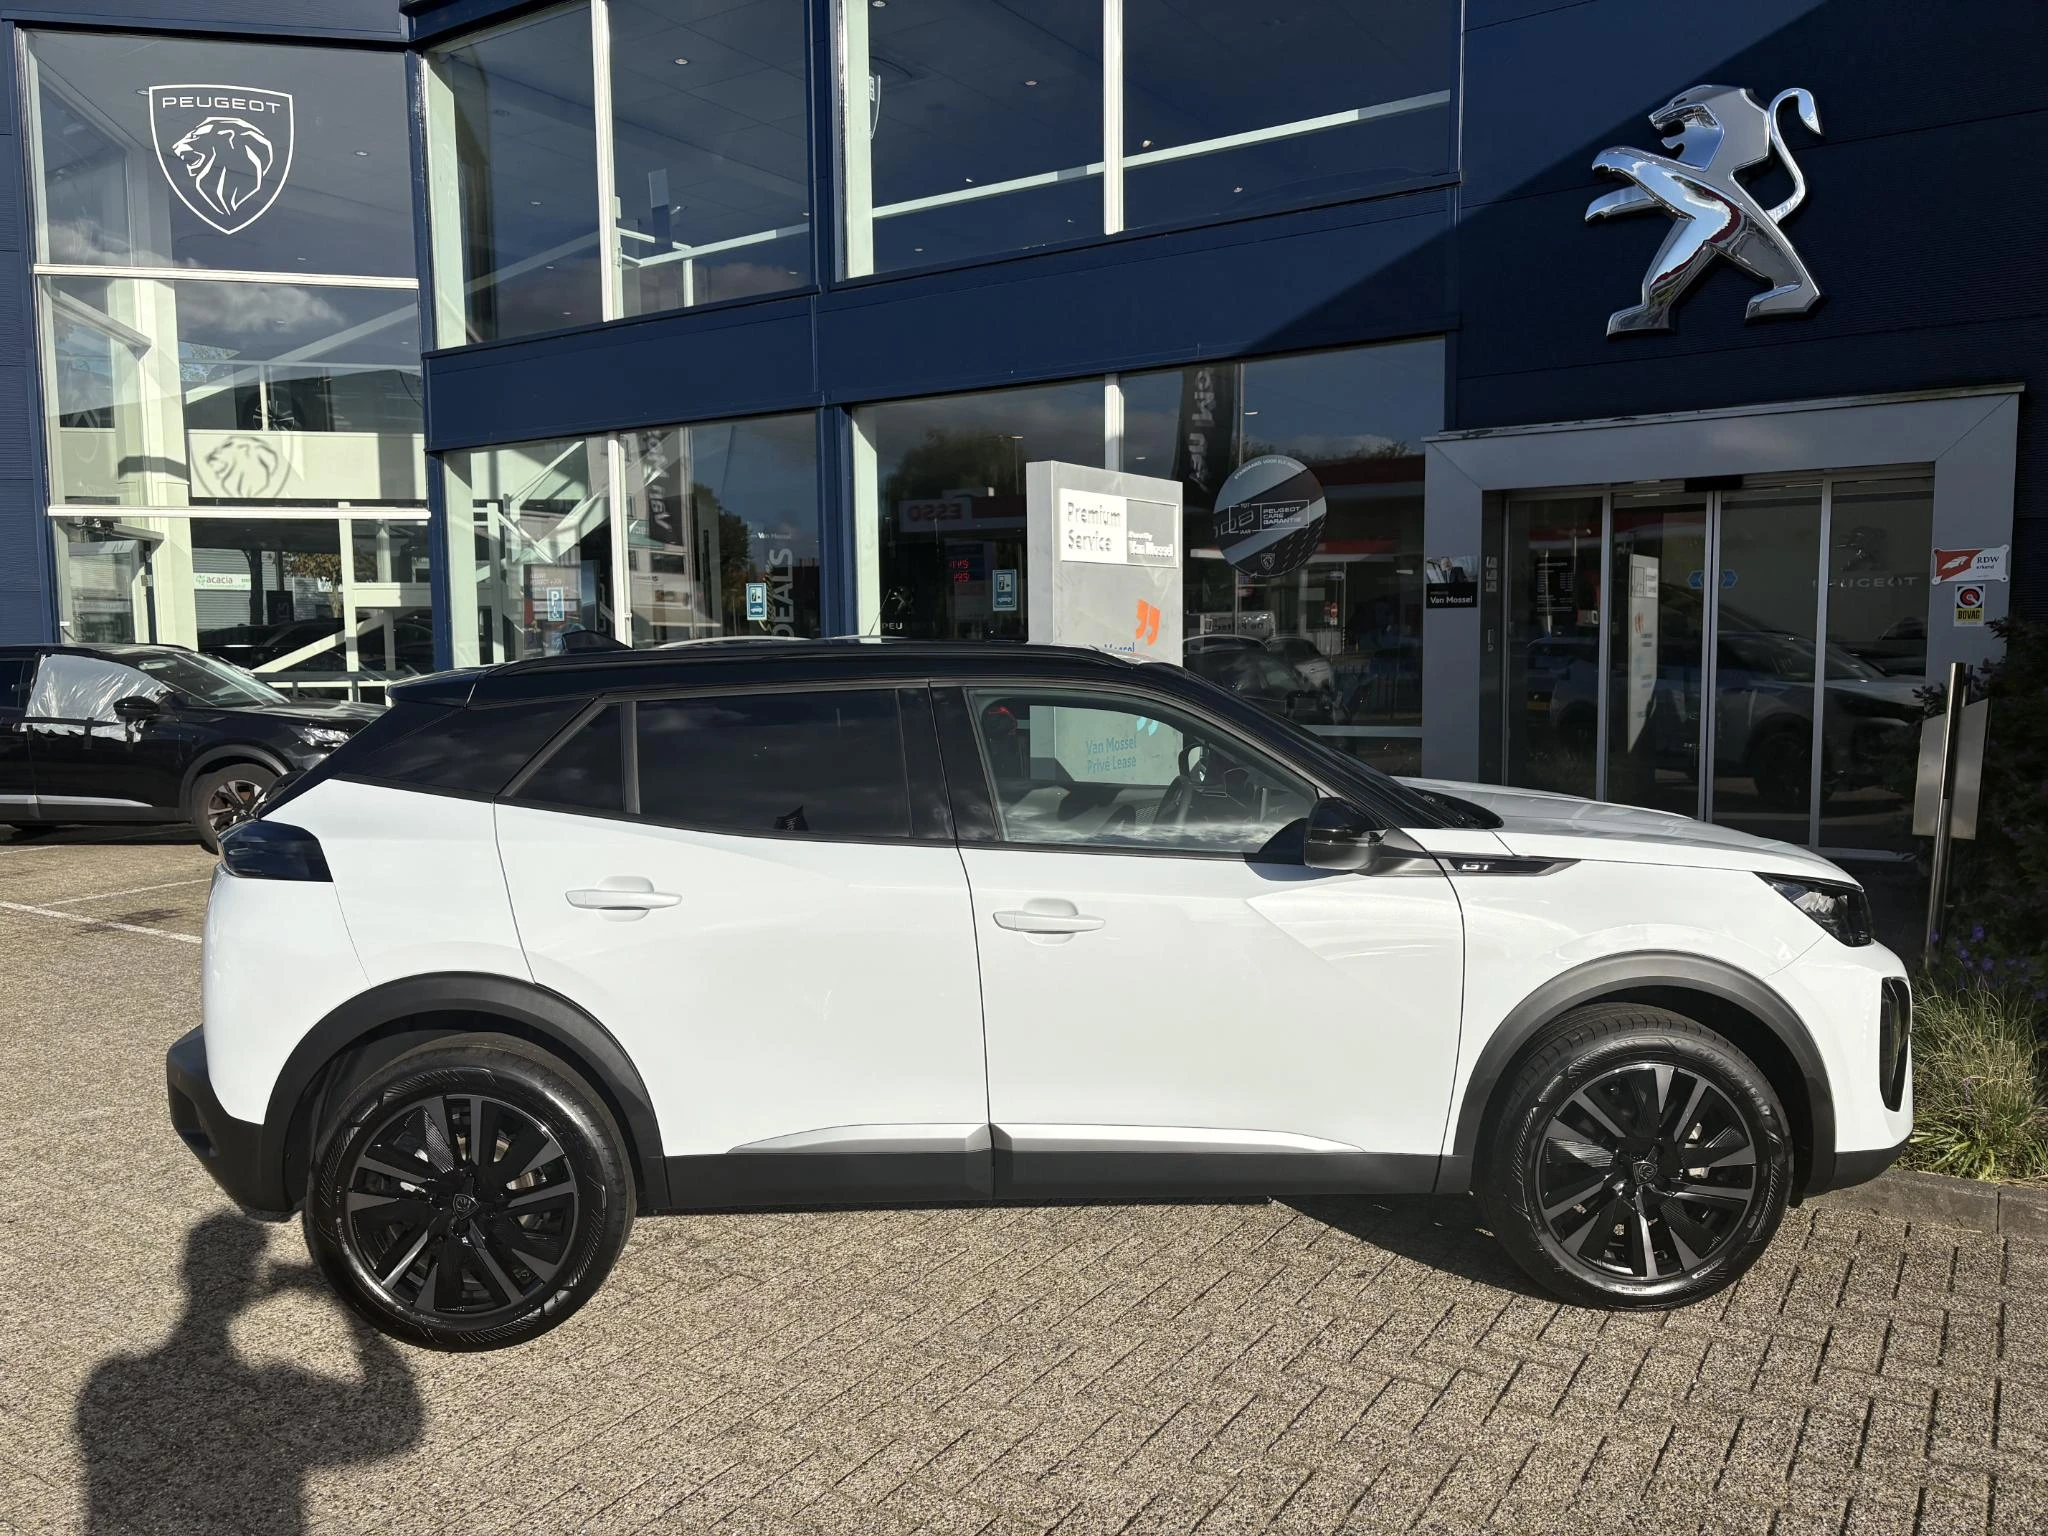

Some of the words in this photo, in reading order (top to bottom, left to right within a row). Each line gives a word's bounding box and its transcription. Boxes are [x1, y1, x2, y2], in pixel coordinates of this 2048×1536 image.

[162, 96, 281, 114] PEUGEOT
[1067, 502, 1121, 527] Premium
[1263, 506, 1301, 514] PEUGEOT
[1068, 529, 1112, 552] Service
[1976, 556, 2000, 564] RDW
[206, 575, 233, 584] acacia
[1430, 596, 1445, 604] Van
[1446, 595, 1473, 604] Mossel
[1957, 610, 1981, 620] BOVAG
[1086, 741, 1104, 754] Van
[1106, 736, 1137, 752] Mossel
[1112, 755, 1137, 770] Lease
[1462, 862, 1495, 871] GT
